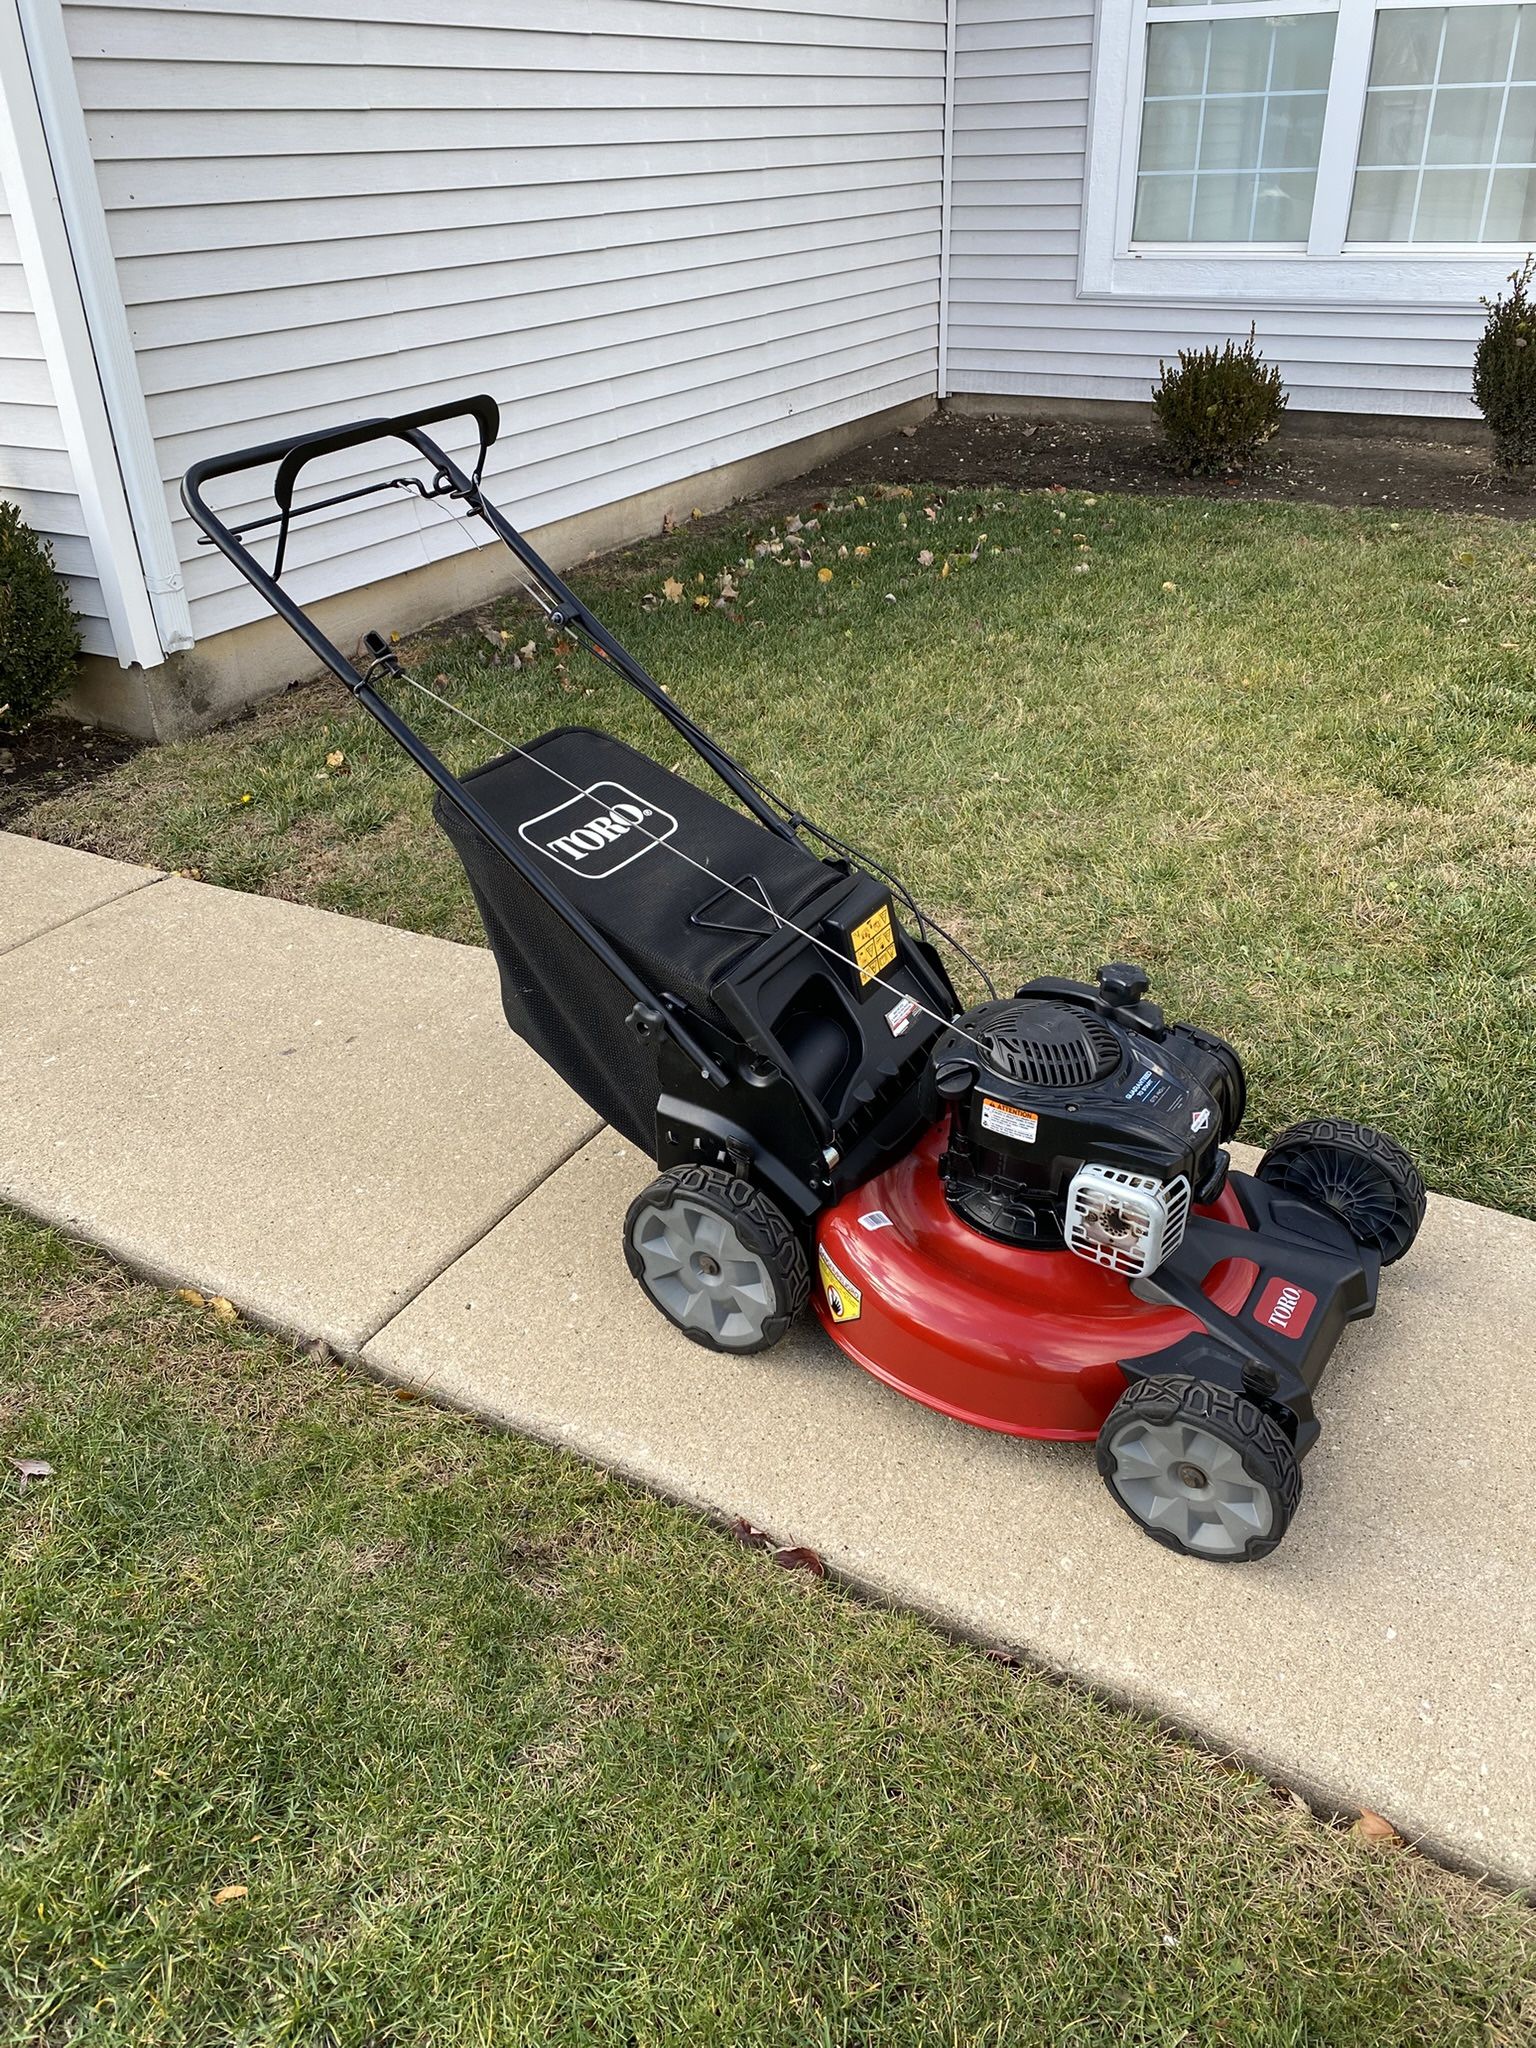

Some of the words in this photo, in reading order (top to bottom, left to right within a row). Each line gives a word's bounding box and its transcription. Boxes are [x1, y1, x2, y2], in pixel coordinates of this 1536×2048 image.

[546, 803, 645, 861] TORO
[1124, 1070, 1153, 1100] GUARANTEED
[997, 1103, 1032, 1119] ATTENTION
[1267, 1287, 1301, 1329] TORO
